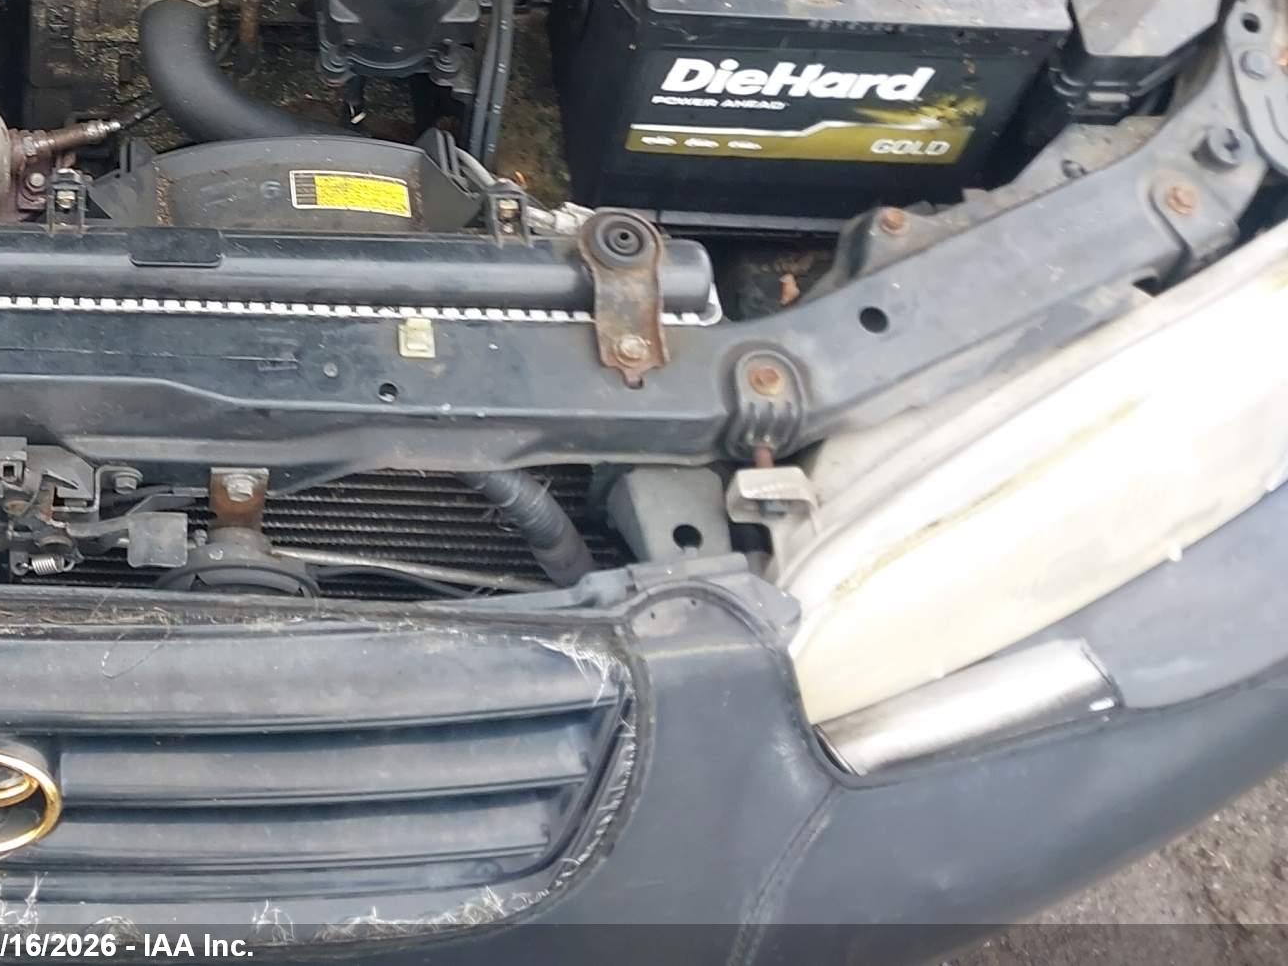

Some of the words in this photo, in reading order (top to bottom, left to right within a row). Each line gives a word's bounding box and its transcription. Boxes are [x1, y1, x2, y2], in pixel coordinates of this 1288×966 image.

[661, 57, 936, 101] DieHard
[650, 95, 717, 108] POWER
[870, 139, 951, 156] GOLD
